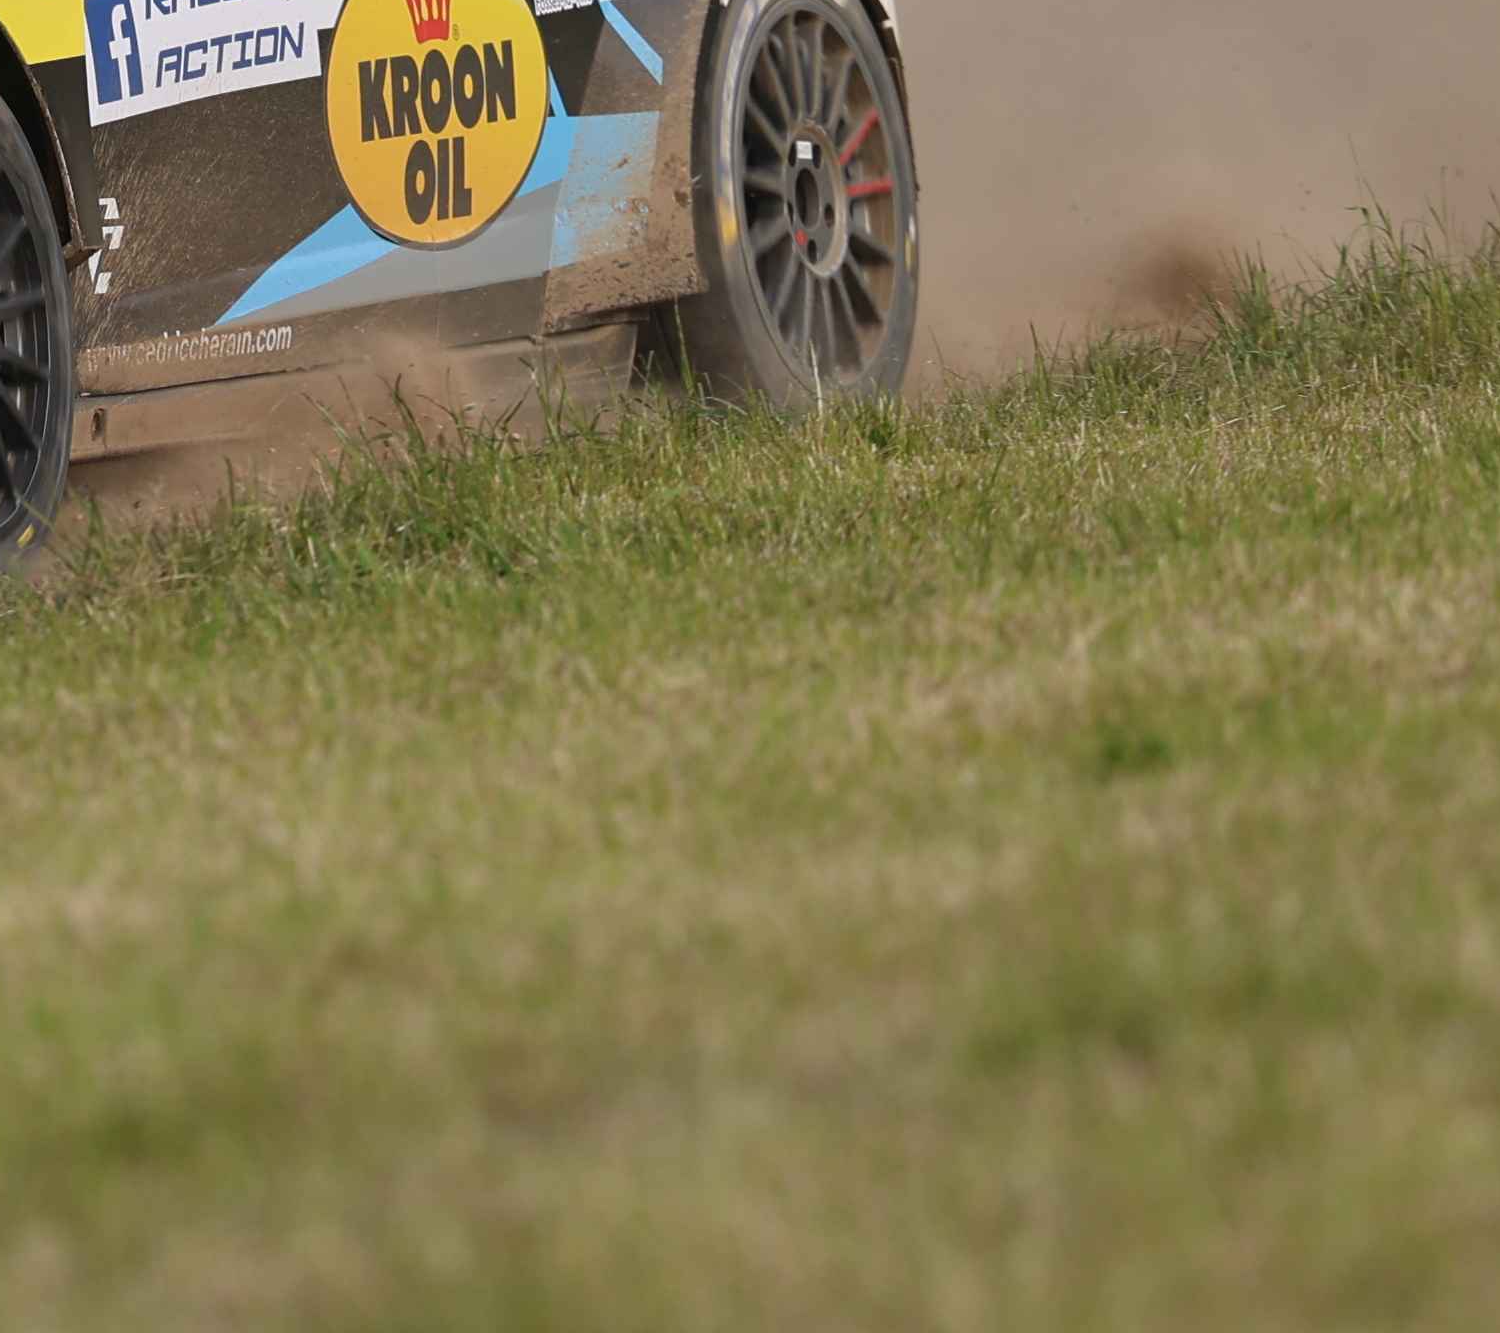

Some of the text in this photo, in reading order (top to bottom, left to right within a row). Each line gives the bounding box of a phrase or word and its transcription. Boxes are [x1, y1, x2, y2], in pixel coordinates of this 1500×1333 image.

[155, 21, 304, 88] ACTION
[358, 39, 516, 143] KROON
[404, 136, 473, 225] OIL
